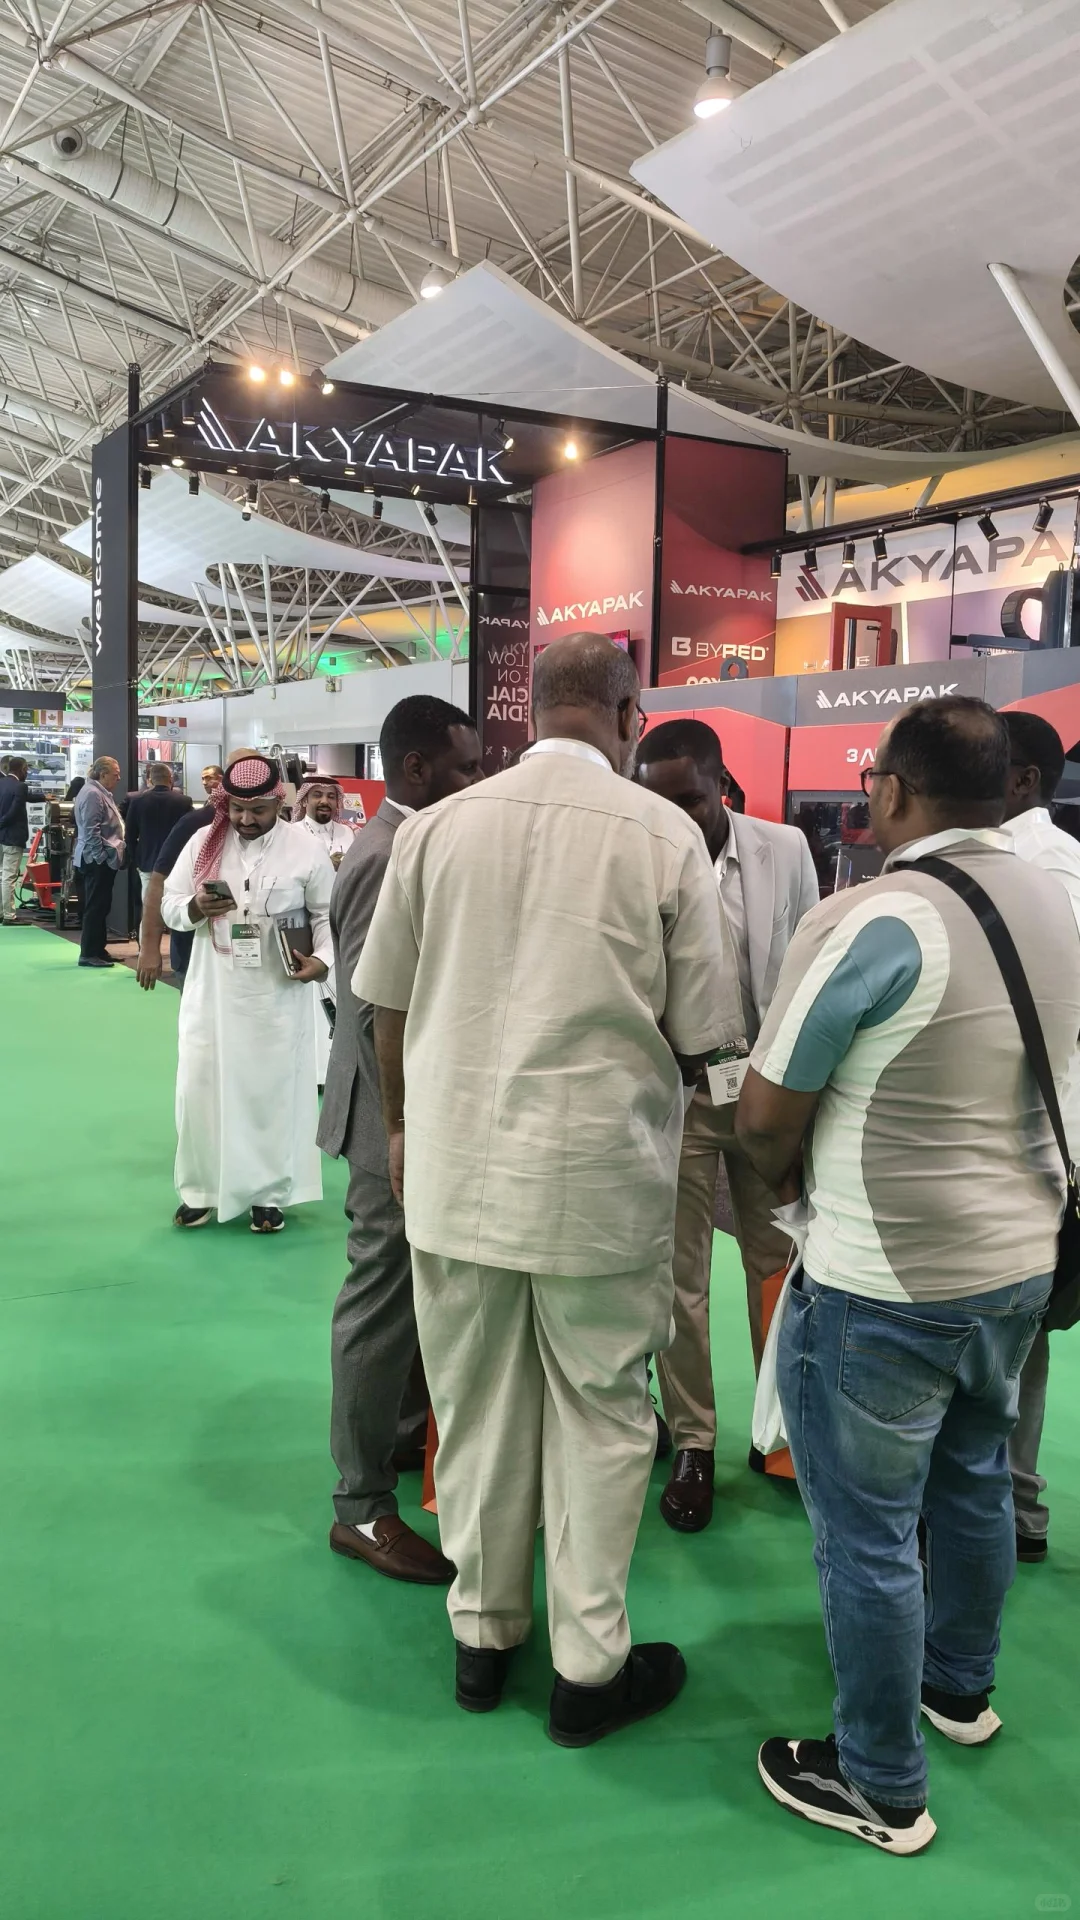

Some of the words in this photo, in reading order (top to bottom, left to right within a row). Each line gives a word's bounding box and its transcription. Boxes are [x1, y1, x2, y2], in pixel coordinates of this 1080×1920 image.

[245, 416, 513, 486] AKYAPAK
[94, 478, 103, 656] welcome
[550, 590, 644, 624] AKYAPAK
[684, 584, 773, 603] AKYAPAK
[834, 683, 959, 708] AKYAPAK
